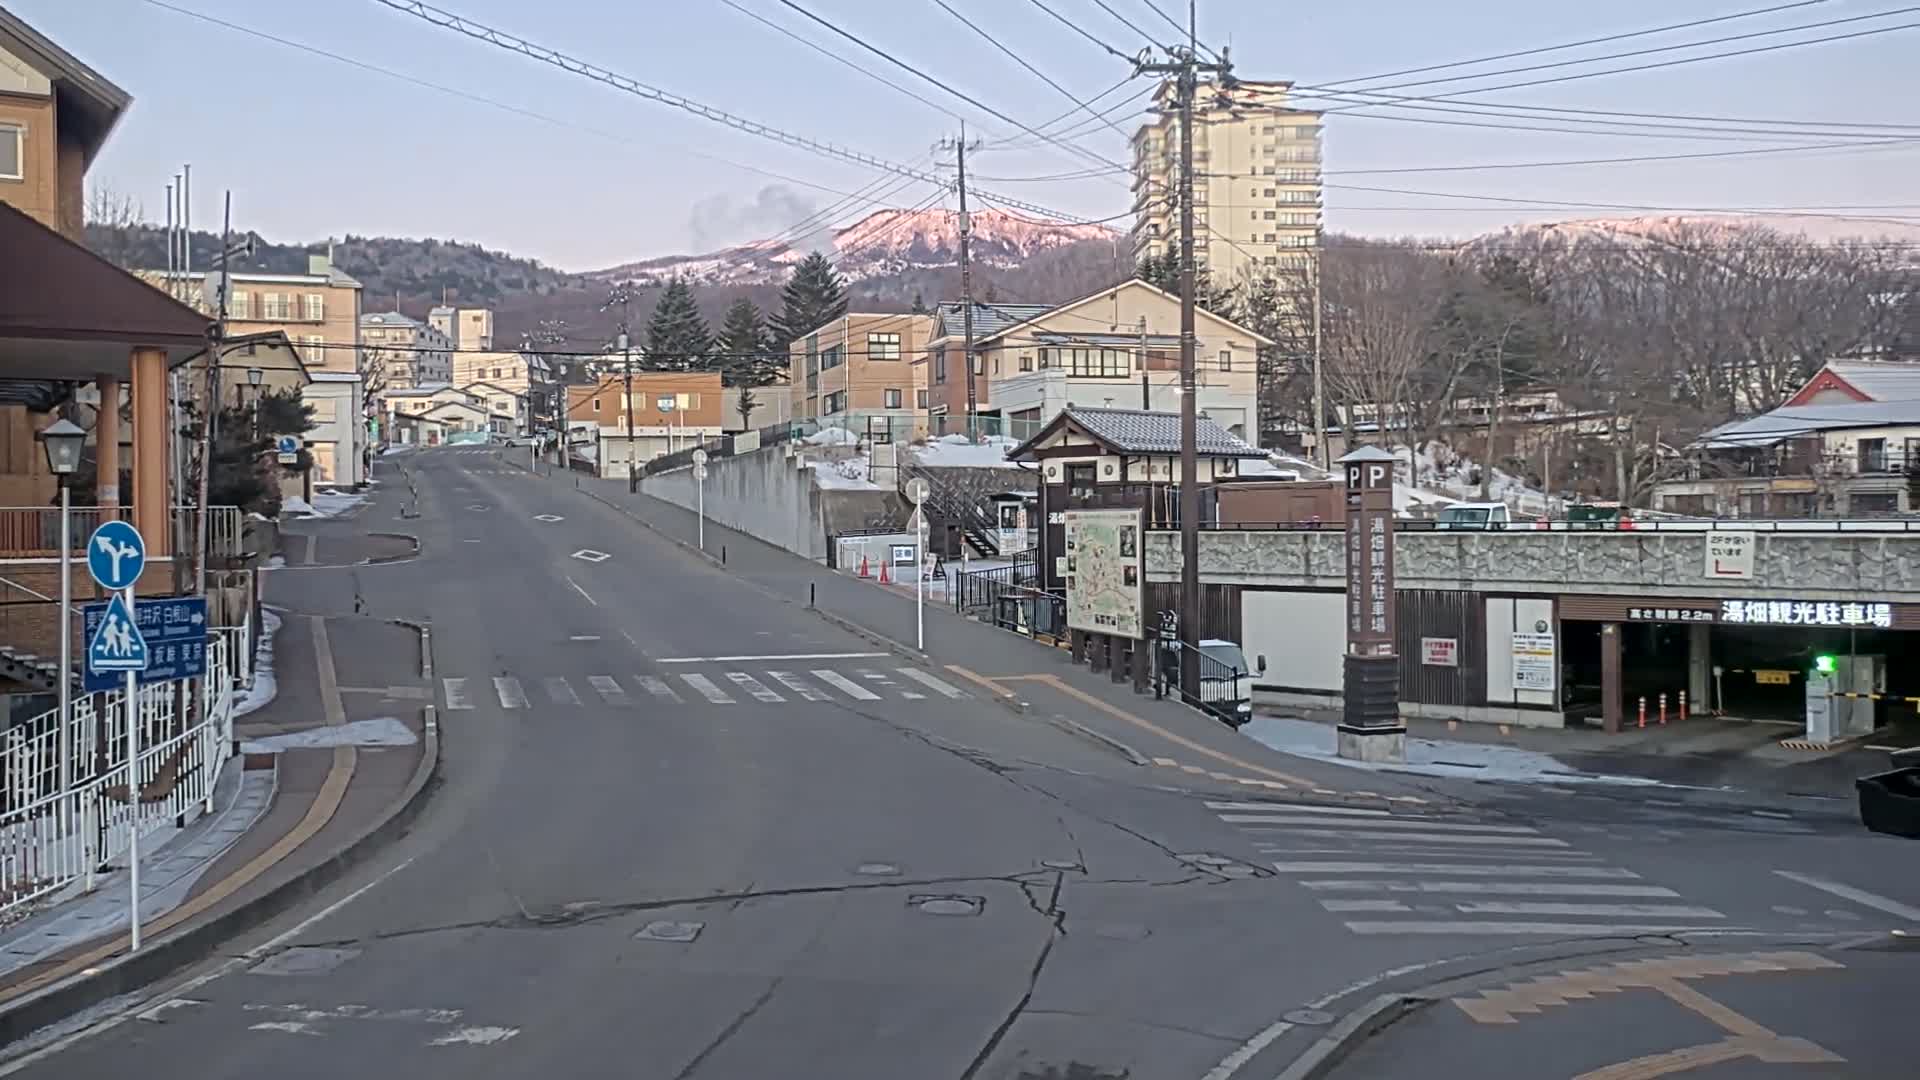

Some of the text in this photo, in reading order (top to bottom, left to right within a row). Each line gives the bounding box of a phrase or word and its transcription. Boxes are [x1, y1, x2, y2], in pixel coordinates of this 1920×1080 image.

[1350, 466, 1360, 488] P
[1369, 466, 1385, 488] P
[1370, 517, 1386, 633] 湯畑観光駐車場
[1721, 600, 1891, 628] 湯畑観光駐車場
